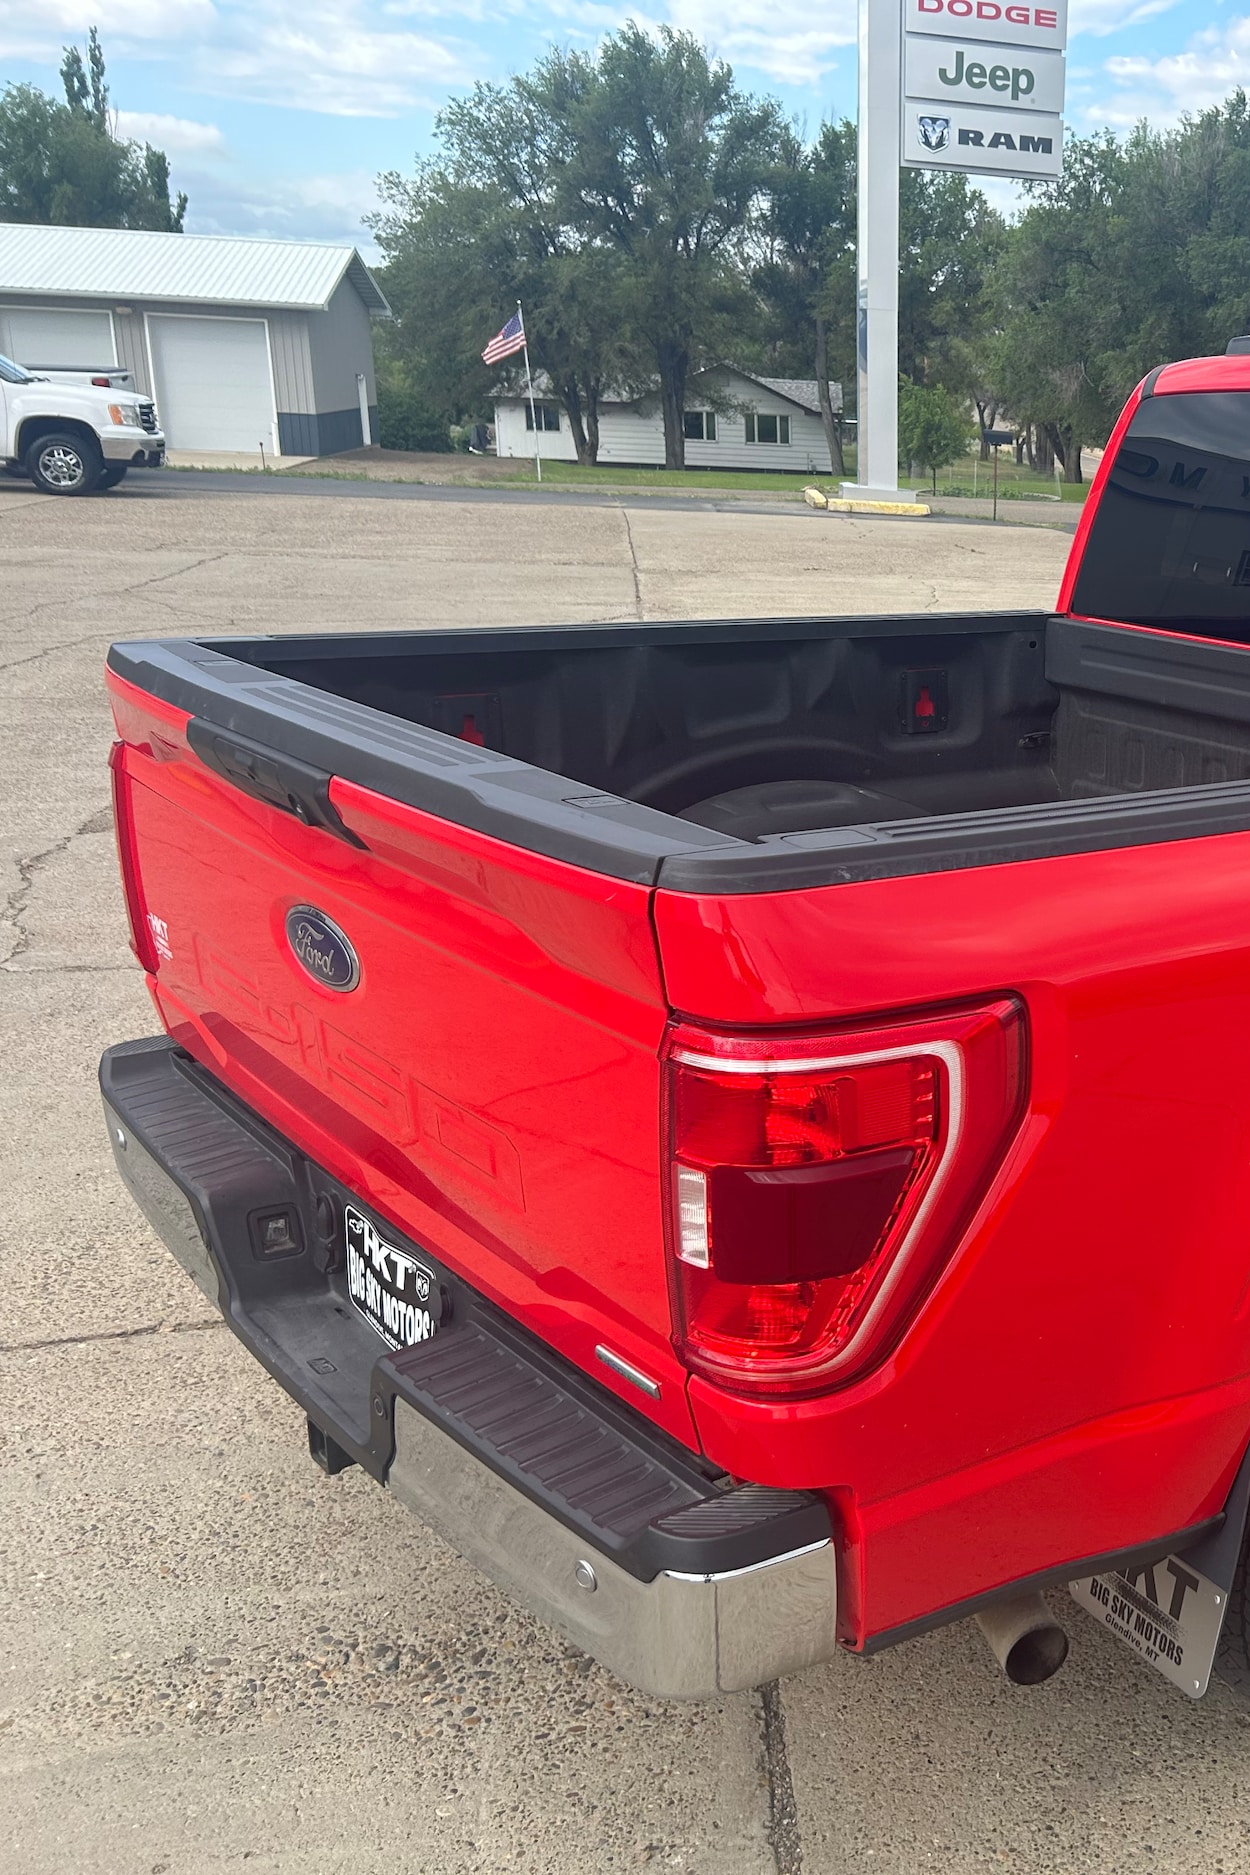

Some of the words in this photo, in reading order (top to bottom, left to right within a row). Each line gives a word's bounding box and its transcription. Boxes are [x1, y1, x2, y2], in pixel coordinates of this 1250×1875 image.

[918, 0, 1057, 29] DODGE
[938, 50, 1035, 101] Jeep
[958, 128, 1053, 155] RAM
[295, 921, 335, 977] Ford
[363, 1221, 410, 1291] HKT
[349, 1243, 365, 1302] BIG
[365, 1266, 382, 1318] SKY
[382, 1289, 430, 1347] MOTORS
[1089, 1576, 1110, 1608] BIG
[1110, 1591, 1136, 1625] SKY
[1134, 1609, 1184, 1666] MOTORS
[1105, 1613, 1143, 1652] Glendive,
[1144, 1644, 1161, 1662] MT
